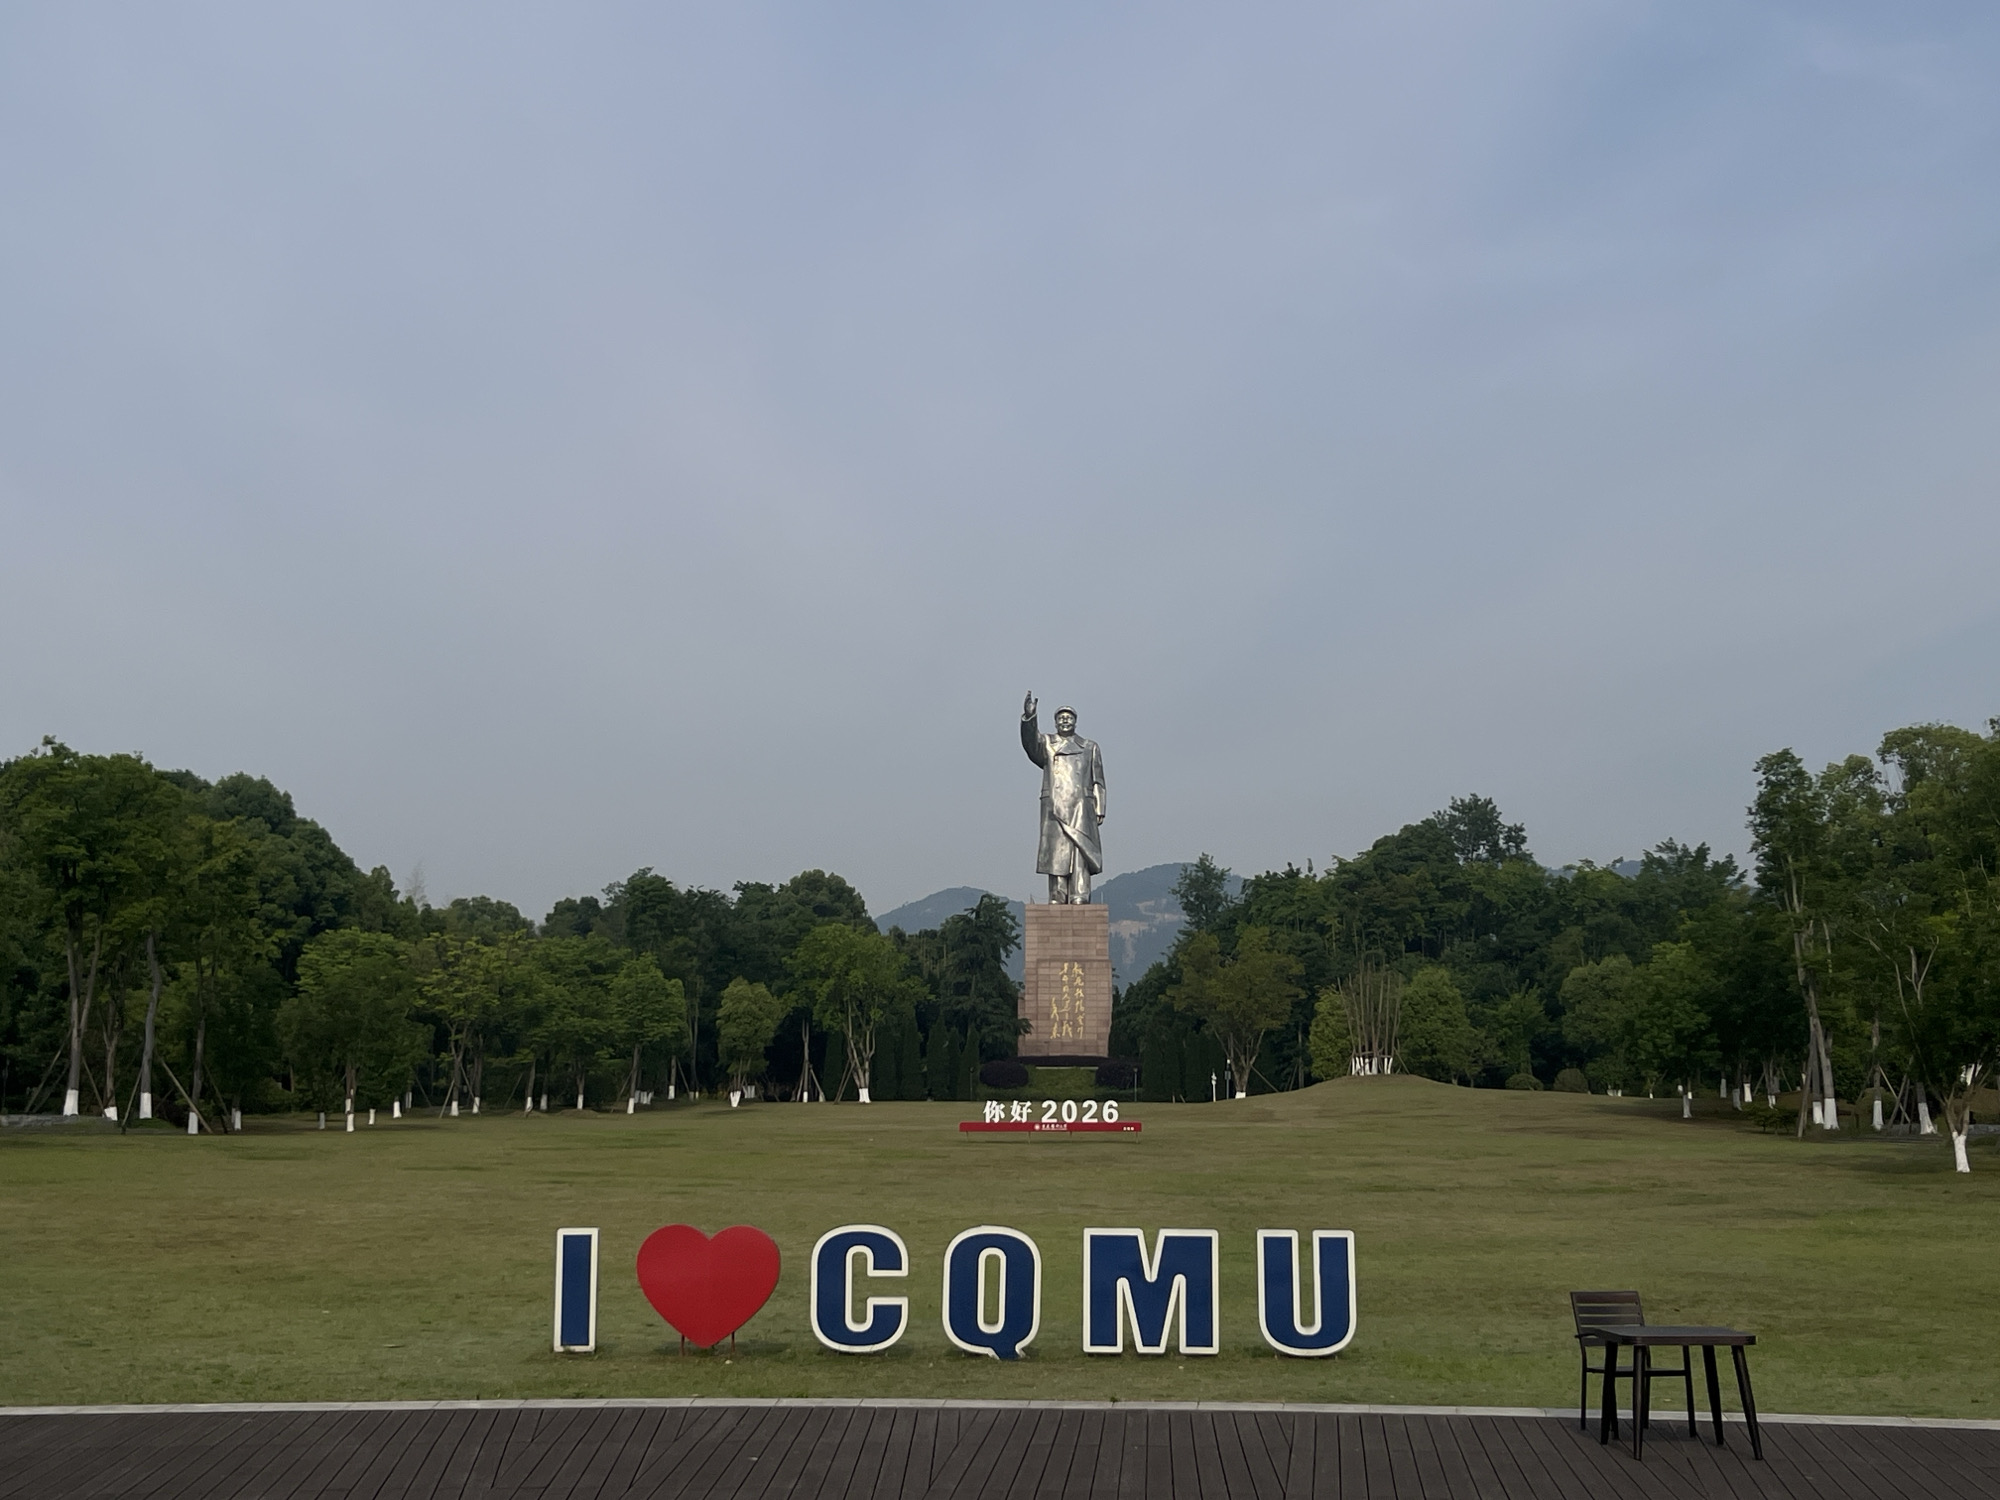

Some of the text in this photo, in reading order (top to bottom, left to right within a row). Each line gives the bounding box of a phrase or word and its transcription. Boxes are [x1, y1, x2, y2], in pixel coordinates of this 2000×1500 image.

[983, 1100, 1119, 1123] 你好 2026
[553, 1224, 1358, 1360] I CQMU
